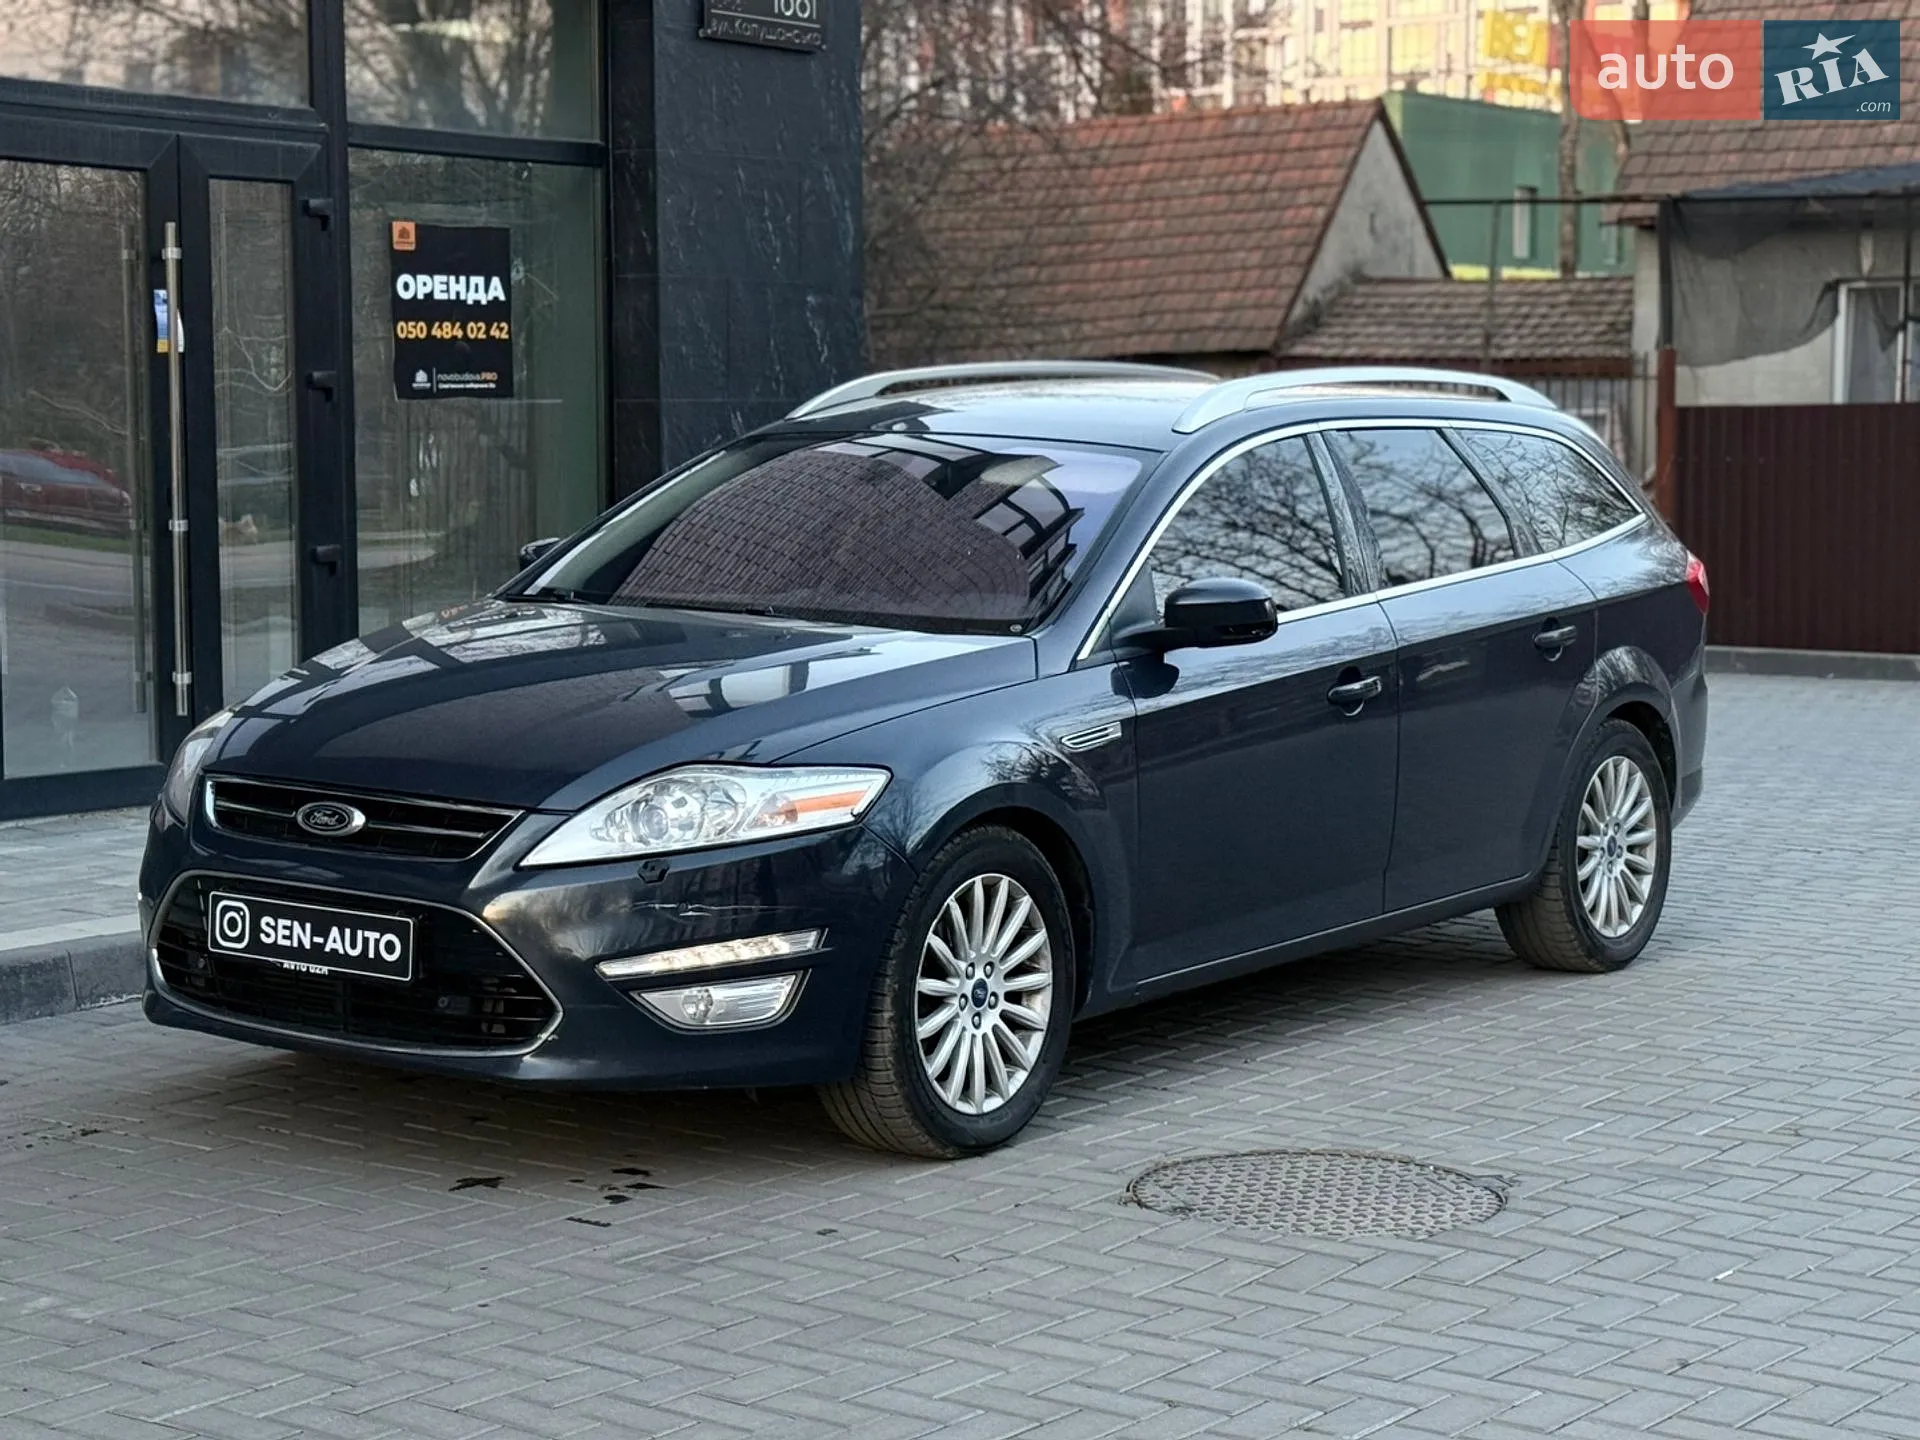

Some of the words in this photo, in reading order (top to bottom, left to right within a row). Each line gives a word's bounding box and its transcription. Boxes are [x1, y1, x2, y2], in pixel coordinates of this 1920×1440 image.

[396, 273, 506, 305] ОРЕНДА
[396, 321, 427, 339] 050
[431, 321, 463, 339] 484
[466, 321, 487, 339] 02
[489, 321, 509, 339] 42
[310, 810, 340, 825] Ford
[259, 915, 402, 963] SEN-AUTO
